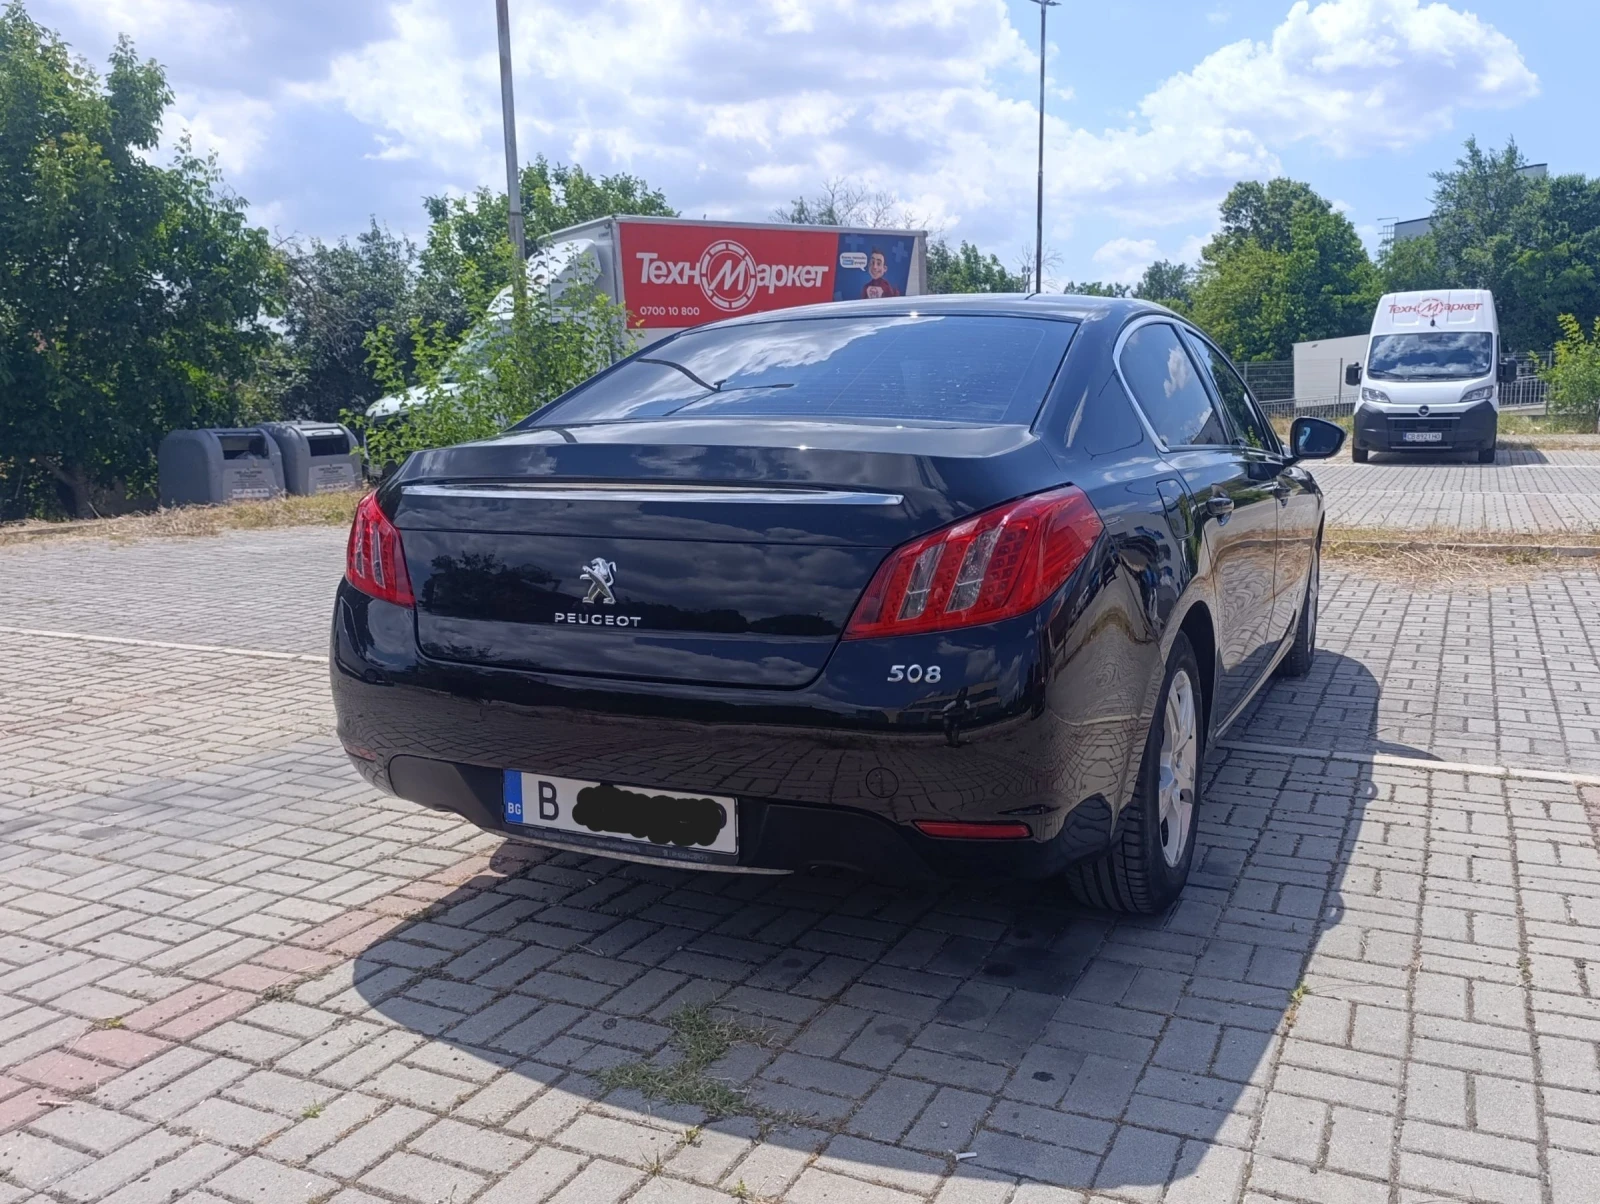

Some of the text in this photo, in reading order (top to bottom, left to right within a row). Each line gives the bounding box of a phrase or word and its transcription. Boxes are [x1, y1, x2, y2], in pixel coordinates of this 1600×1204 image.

[640, 306, 700, 316] 0700 10 800
[554, 612, 642, 628] PEUGEOT
[887, 664, 941, 683] 508
[507, 802, 522, 815] BG
